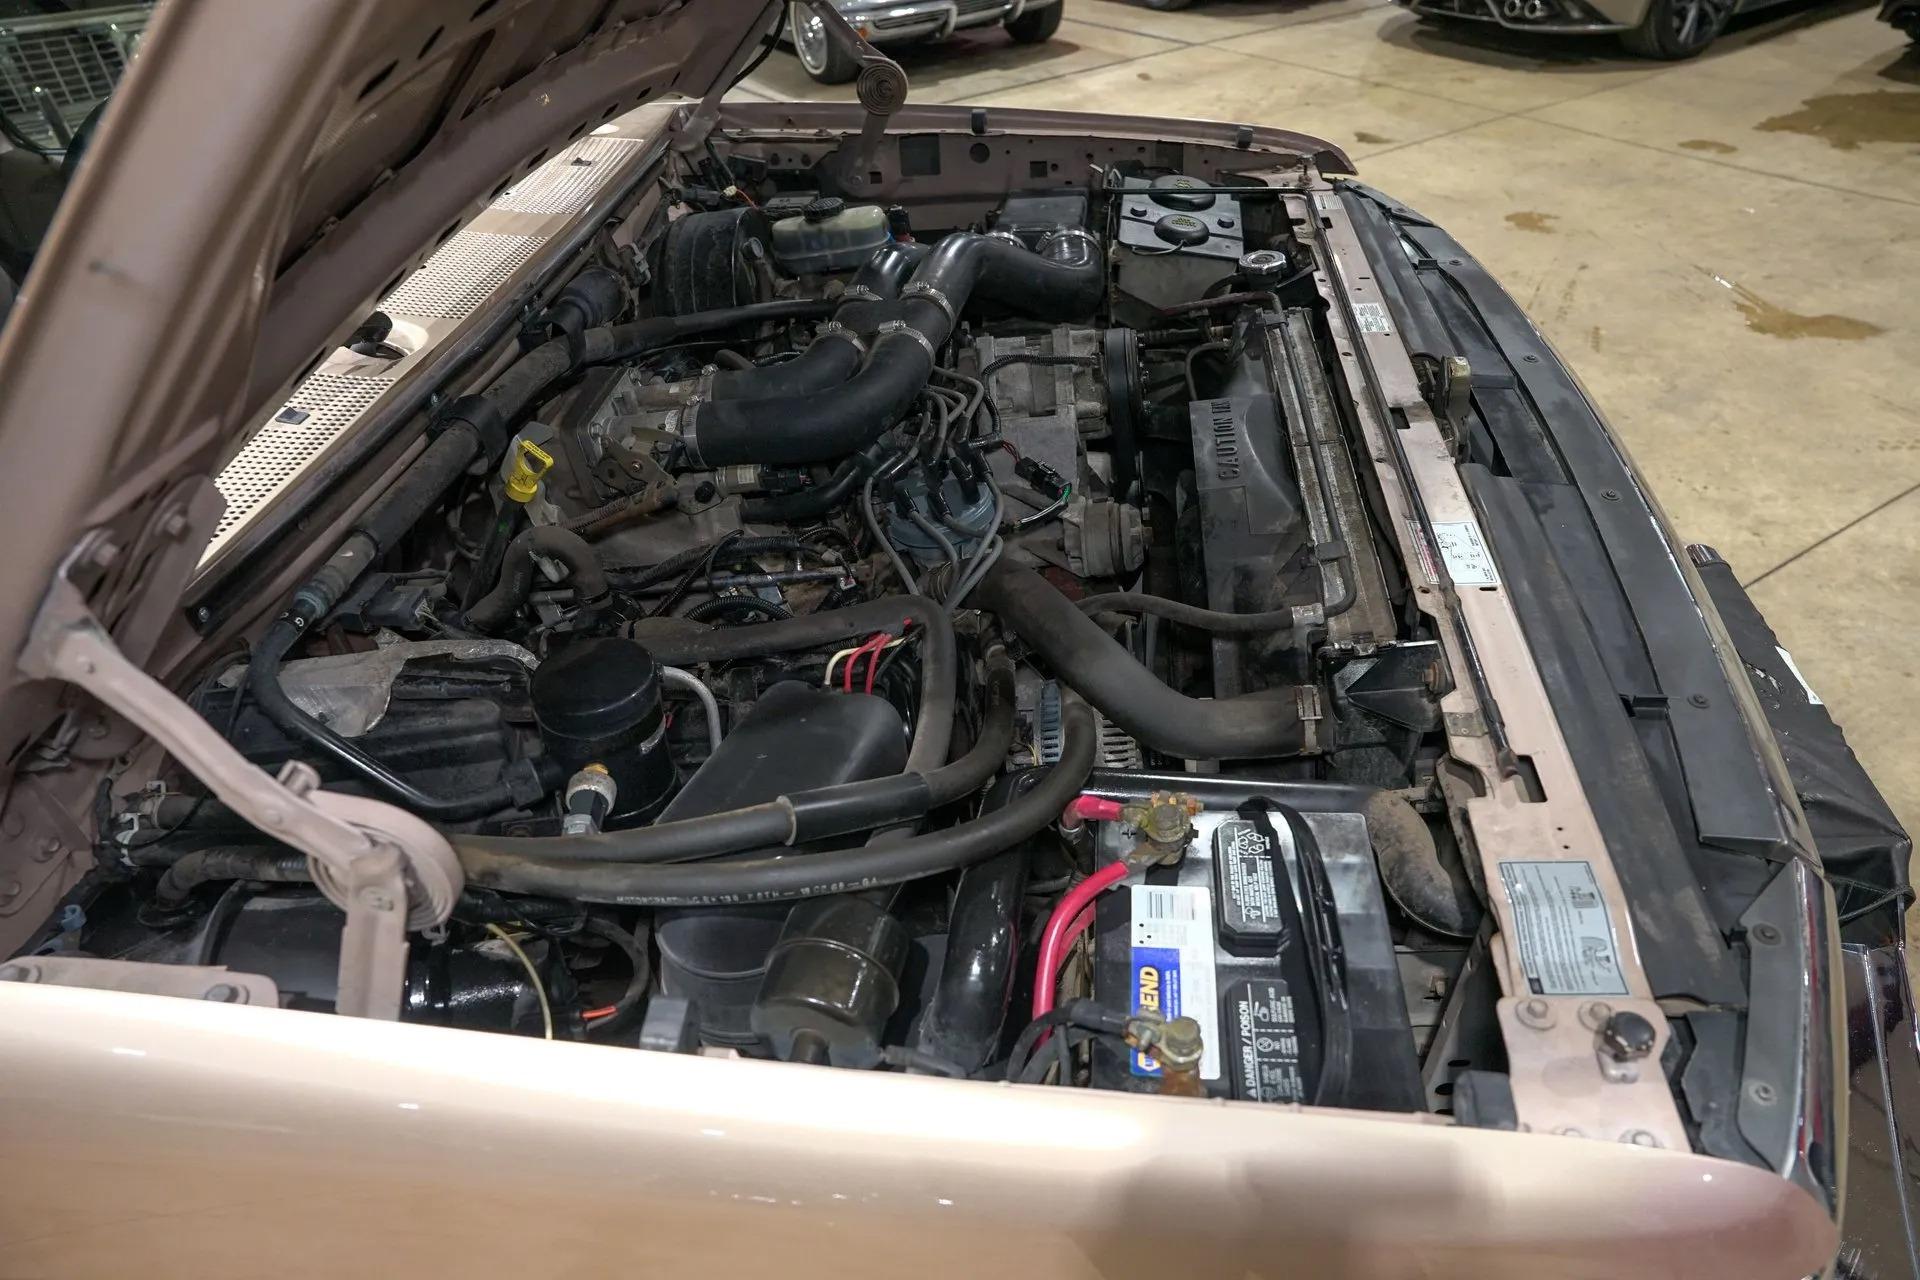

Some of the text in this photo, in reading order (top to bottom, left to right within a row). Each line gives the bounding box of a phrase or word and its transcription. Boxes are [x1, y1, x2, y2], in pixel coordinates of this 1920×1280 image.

[1213, 417, 1241, 481] CAUTION
[1139, 966, 1160, 1008] END
[1238, 1001, 1251, 1037] POISON
[1242, 1046, 1256, 1087] DANGER
